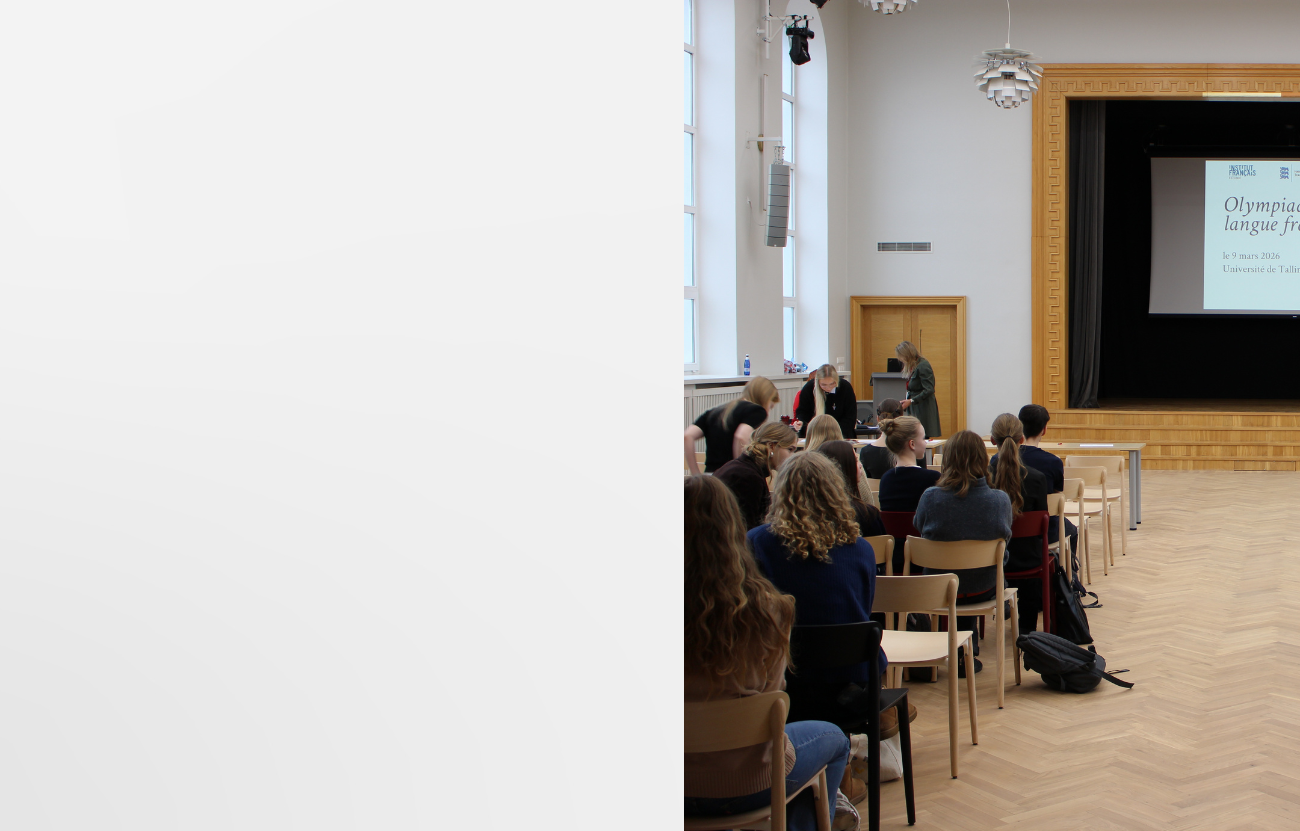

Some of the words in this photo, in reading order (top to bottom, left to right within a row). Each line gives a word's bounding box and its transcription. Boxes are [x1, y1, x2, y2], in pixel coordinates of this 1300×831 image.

[1224, 215, 1278, 236] langue
[1222, 251, 1230, 260] le
[1231, 251, 1237, 260] 9
[1260, 251, 1281, 260] 2026
[1222, 264, 1265, 273] Université
[1266, 265, 1276, 273] de
